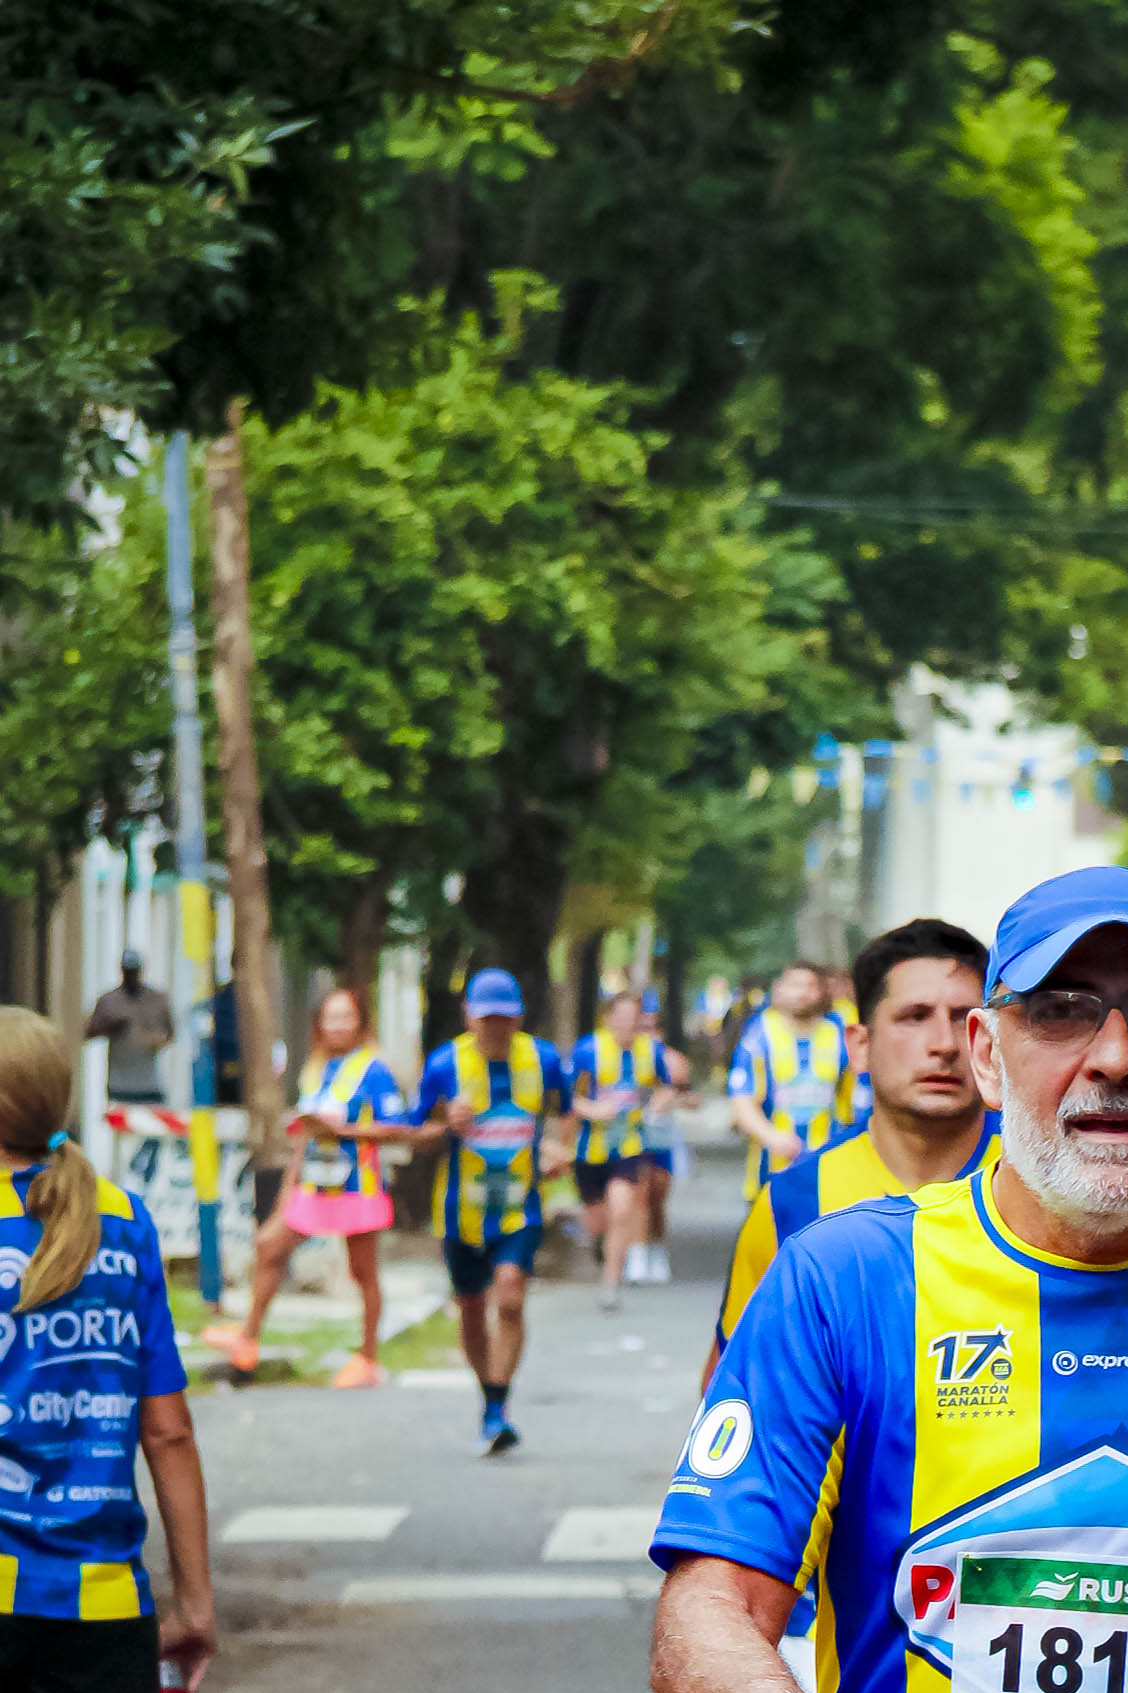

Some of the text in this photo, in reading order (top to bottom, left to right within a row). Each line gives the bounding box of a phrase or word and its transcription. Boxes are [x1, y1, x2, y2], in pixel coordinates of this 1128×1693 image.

[24, 1308, 141, 1350] PORTA
[931, 1328, 1010, 1382] 17
[936, 1382, 1009, 1397] MARATÓN
[937, 1395, 1009, 1408] CANALLA
